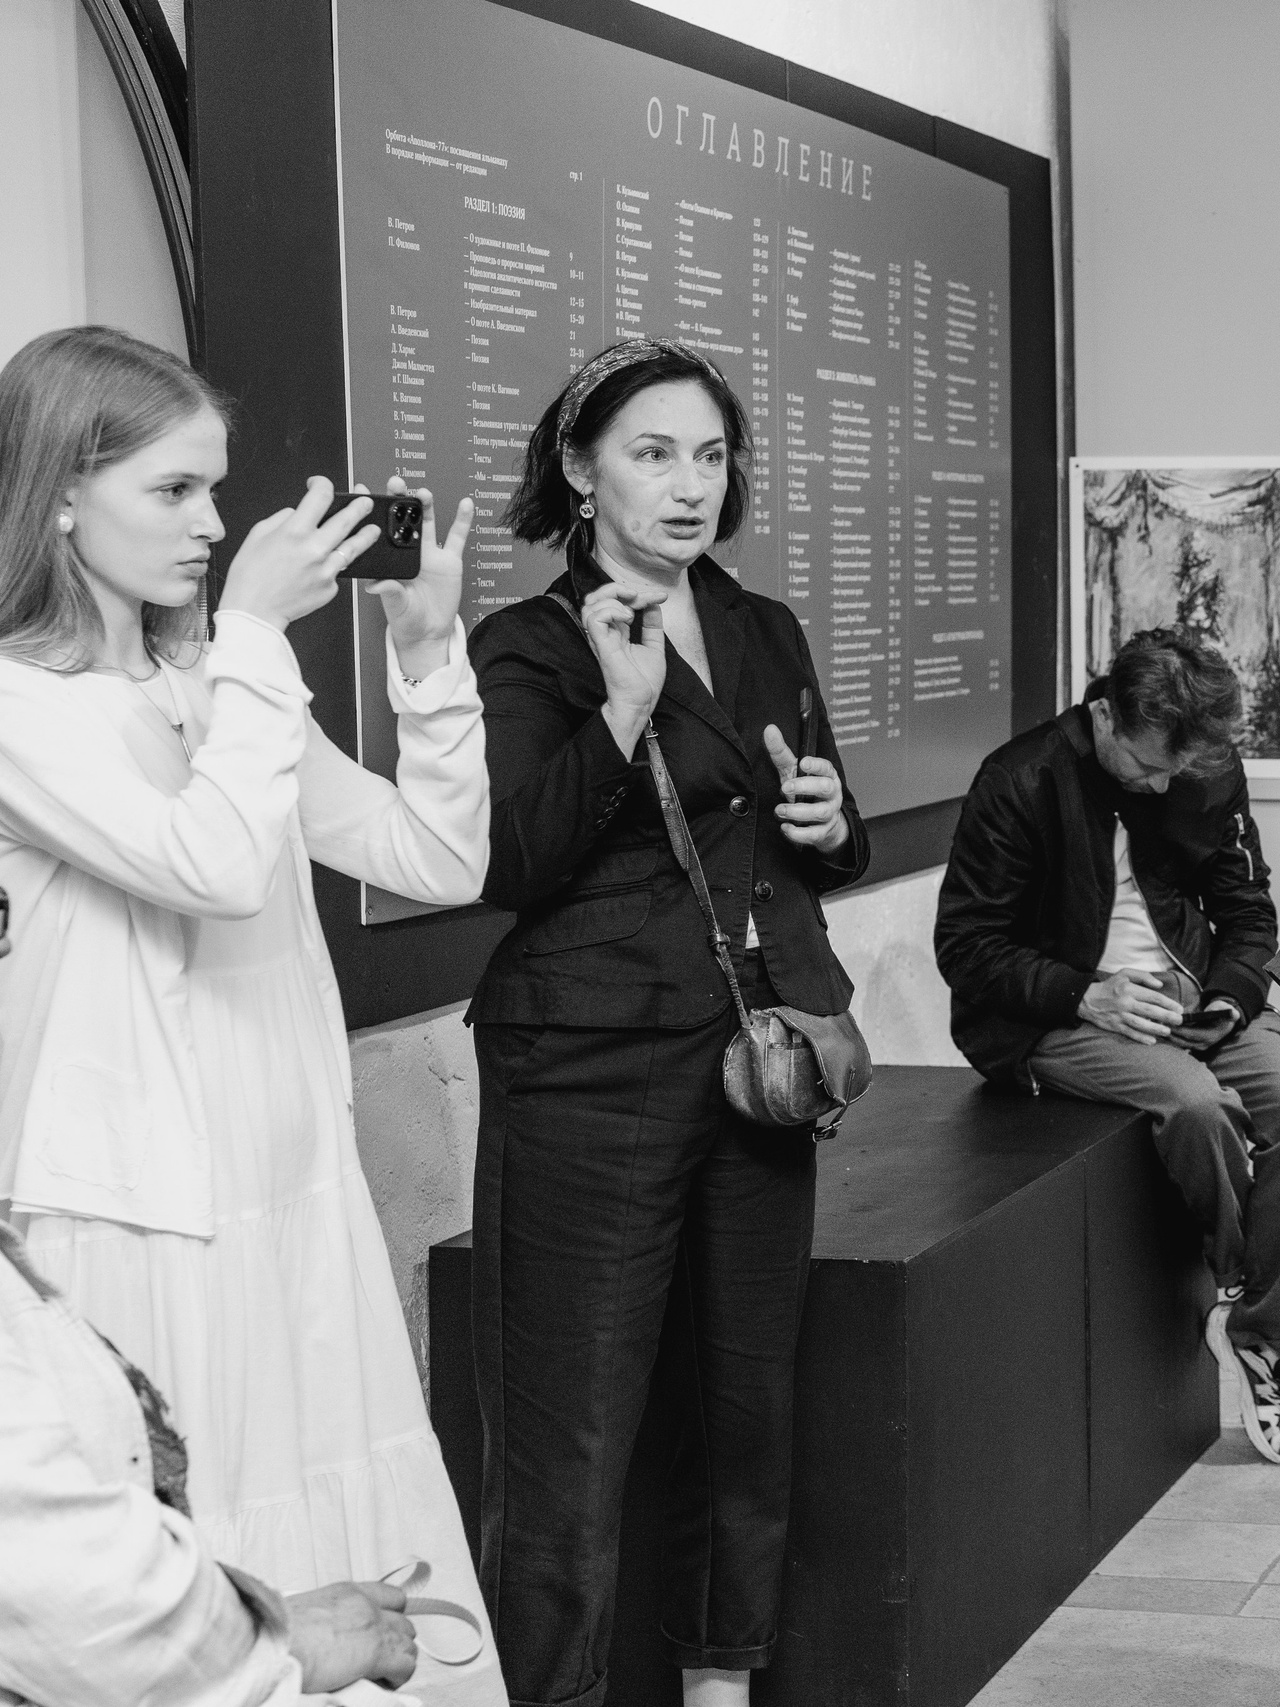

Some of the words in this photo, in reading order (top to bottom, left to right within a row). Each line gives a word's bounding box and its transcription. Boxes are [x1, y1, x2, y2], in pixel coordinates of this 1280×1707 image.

[386, 143, 391, 154] В
[648, 97, 872, 200] ОГЛАВЛЕНИЕ
[464, 196, 490, 212] РАЗДЕЛ
[499, 204, 525, 219] ПОЭЗИЯ
[388, 217, 394, 227] В.
[395, 218, 414, 233] Петров
[470, 232, 474, 243] О
[396, 238, 420, 251] Филонов
[391, 305, 396, 315] В.
[398, 306, 417, 320] Петров
[471, 316, 475, 326] О
[391, 324, 396, 333] А.
[398, 325, 429, 338] Введенский
[391, 343, 397, 354] Д.
[399, 344, 415, 356] Хармс
[392, 358, 407, 369] Джон
[472, 381, 476, 391] О
[393, 392, 399, 401] К.
[400, 393, 421, 403] Вагинов
[394, 411, 400, 420] В.
[394, 429, 400, 439] Э.
[401, 430, 424, 441] Лимонов
[395, 448, 401, 458] В.
[474, 453, 491, 463] Тексты
[402, 467, 425, 478] Лимонов
[475, 507, 493, 517] Тексты
[477, 578, 495, 588] Тексты
